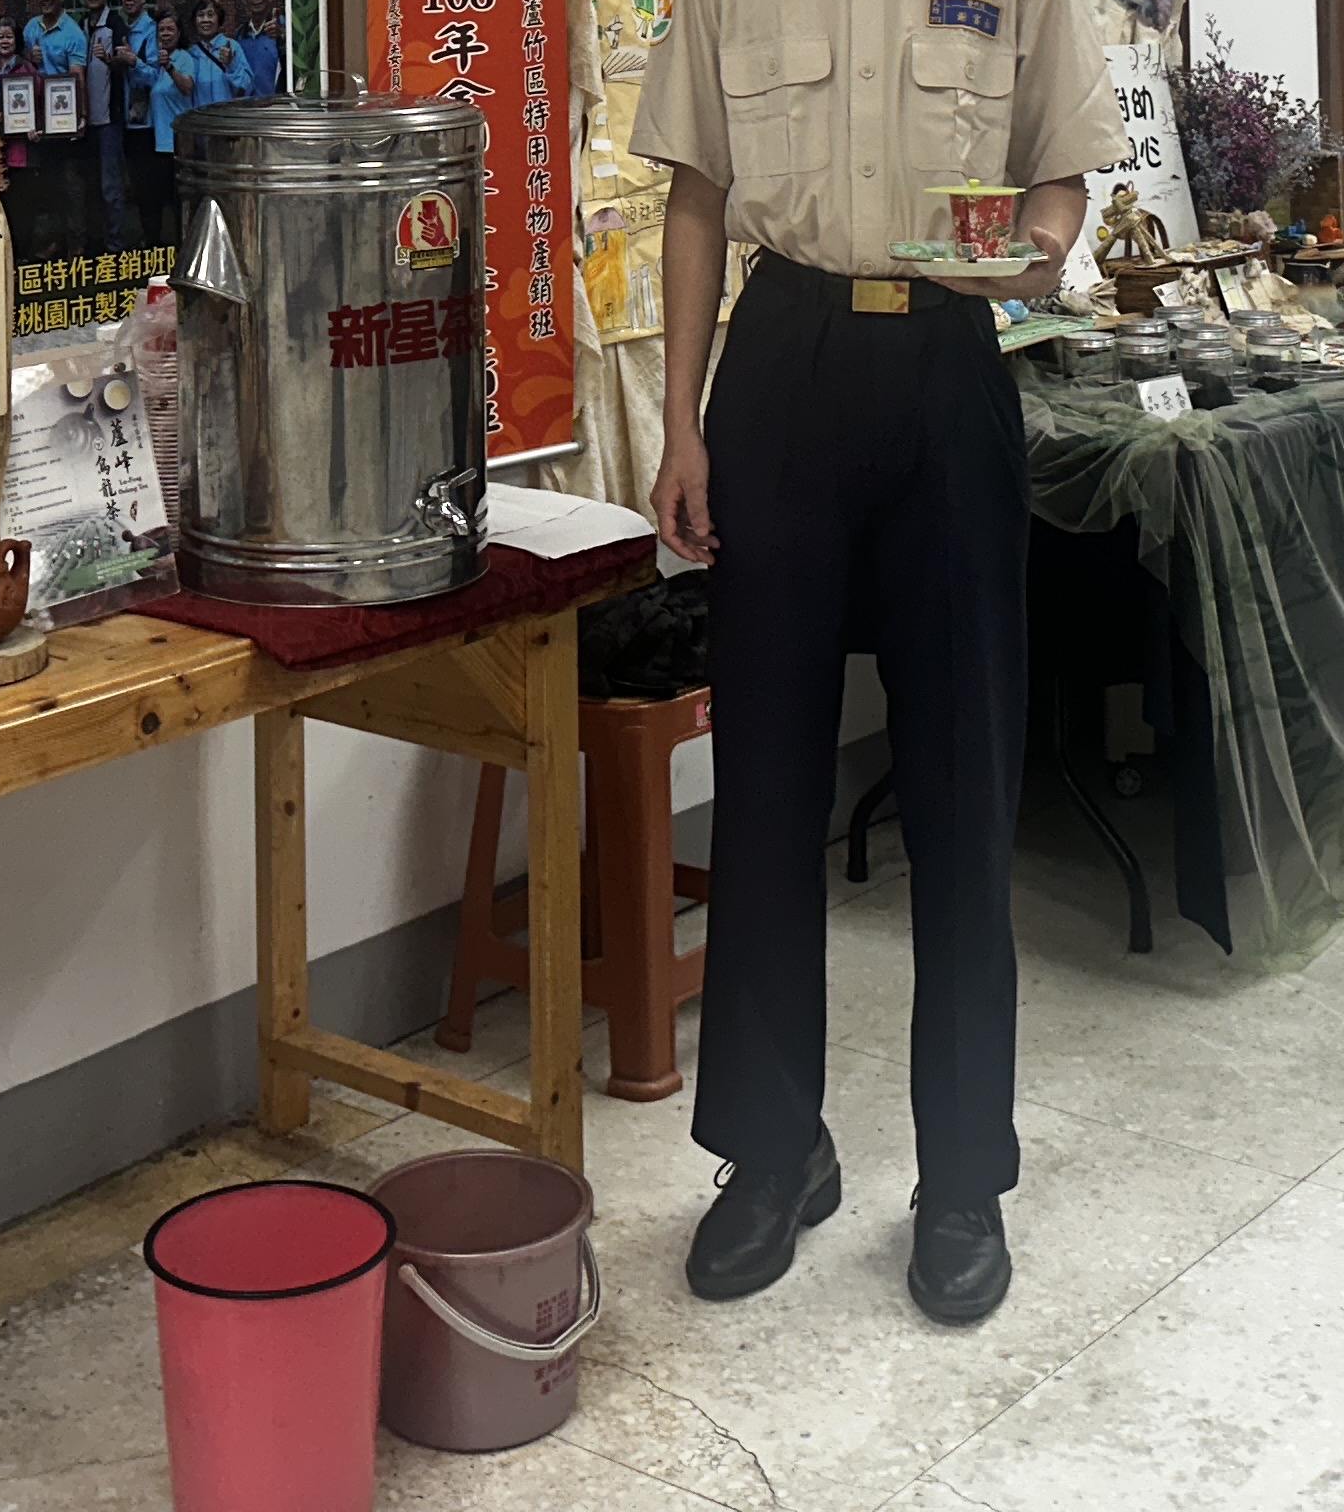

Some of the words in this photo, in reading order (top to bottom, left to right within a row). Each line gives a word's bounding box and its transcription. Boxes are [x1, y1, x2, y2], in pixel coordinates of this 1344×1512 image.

[14, 246, 176, 296] 區特作產銷班
[13, 287, 138, 338] 桃園市製茶
